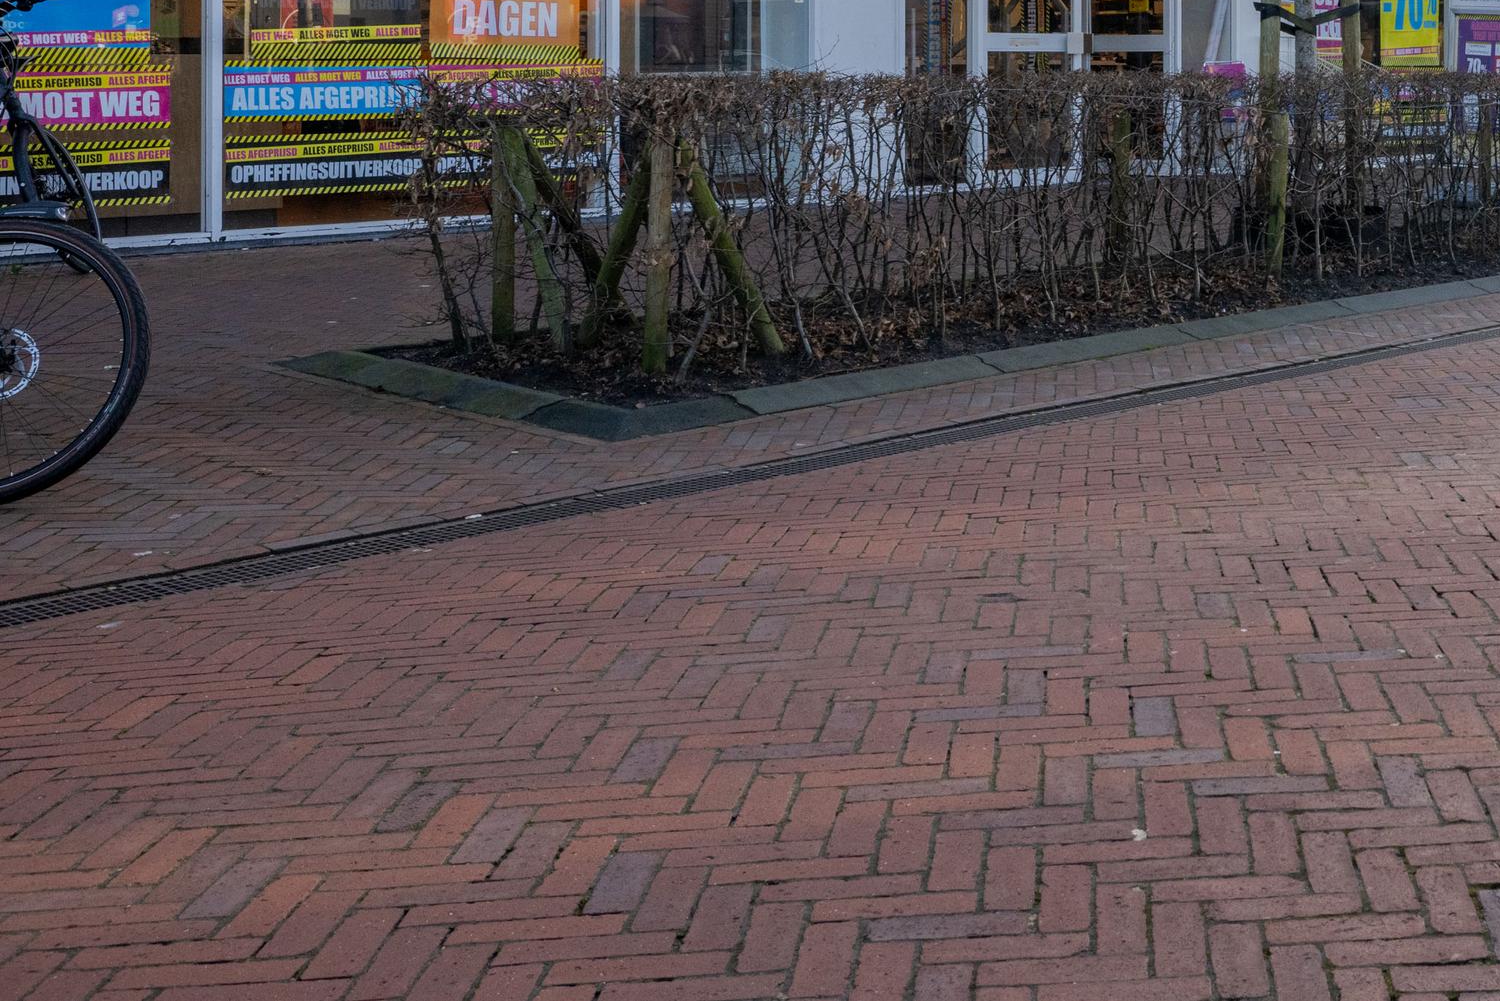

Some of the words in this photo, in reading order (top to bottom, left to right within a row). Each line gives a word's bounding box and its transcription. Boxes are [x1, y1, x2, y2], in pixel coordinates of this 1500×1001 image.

[33, 32, 62, 45] MOET
[63, 32, 89, 44] WEG
[94, 31, 124, 43] ALLES
[299, 29, 324, 39] ALLES
[326, 28, 349, 39] MOET
[351, 27, 370, 38] WEG
[376, 26, 399, 36] ALLES
[45, 76, 102, 88] AFGEPRIJSD
[109, 75, 136, 85] ALLES
[247, 74, 270, 84] MOET
[272, 74, 290, 83] WEG
[295, 72, 318, 82] ALLES
[319, 72, 342, 82] MOET
[343, 71, 361, 81] WEG
[19, 91, 94, 119] MOET
[99, 90, 160, 117] WEG
[232, 87, 294, 111] ALLES
[109, 151, 135, 162] ALLES
[248, 149, 297, 159] AFGEPRIJSD
[303, 146, 326, 156] ALLES
[328, 144, 374, 154] AFGEPRIJSD
